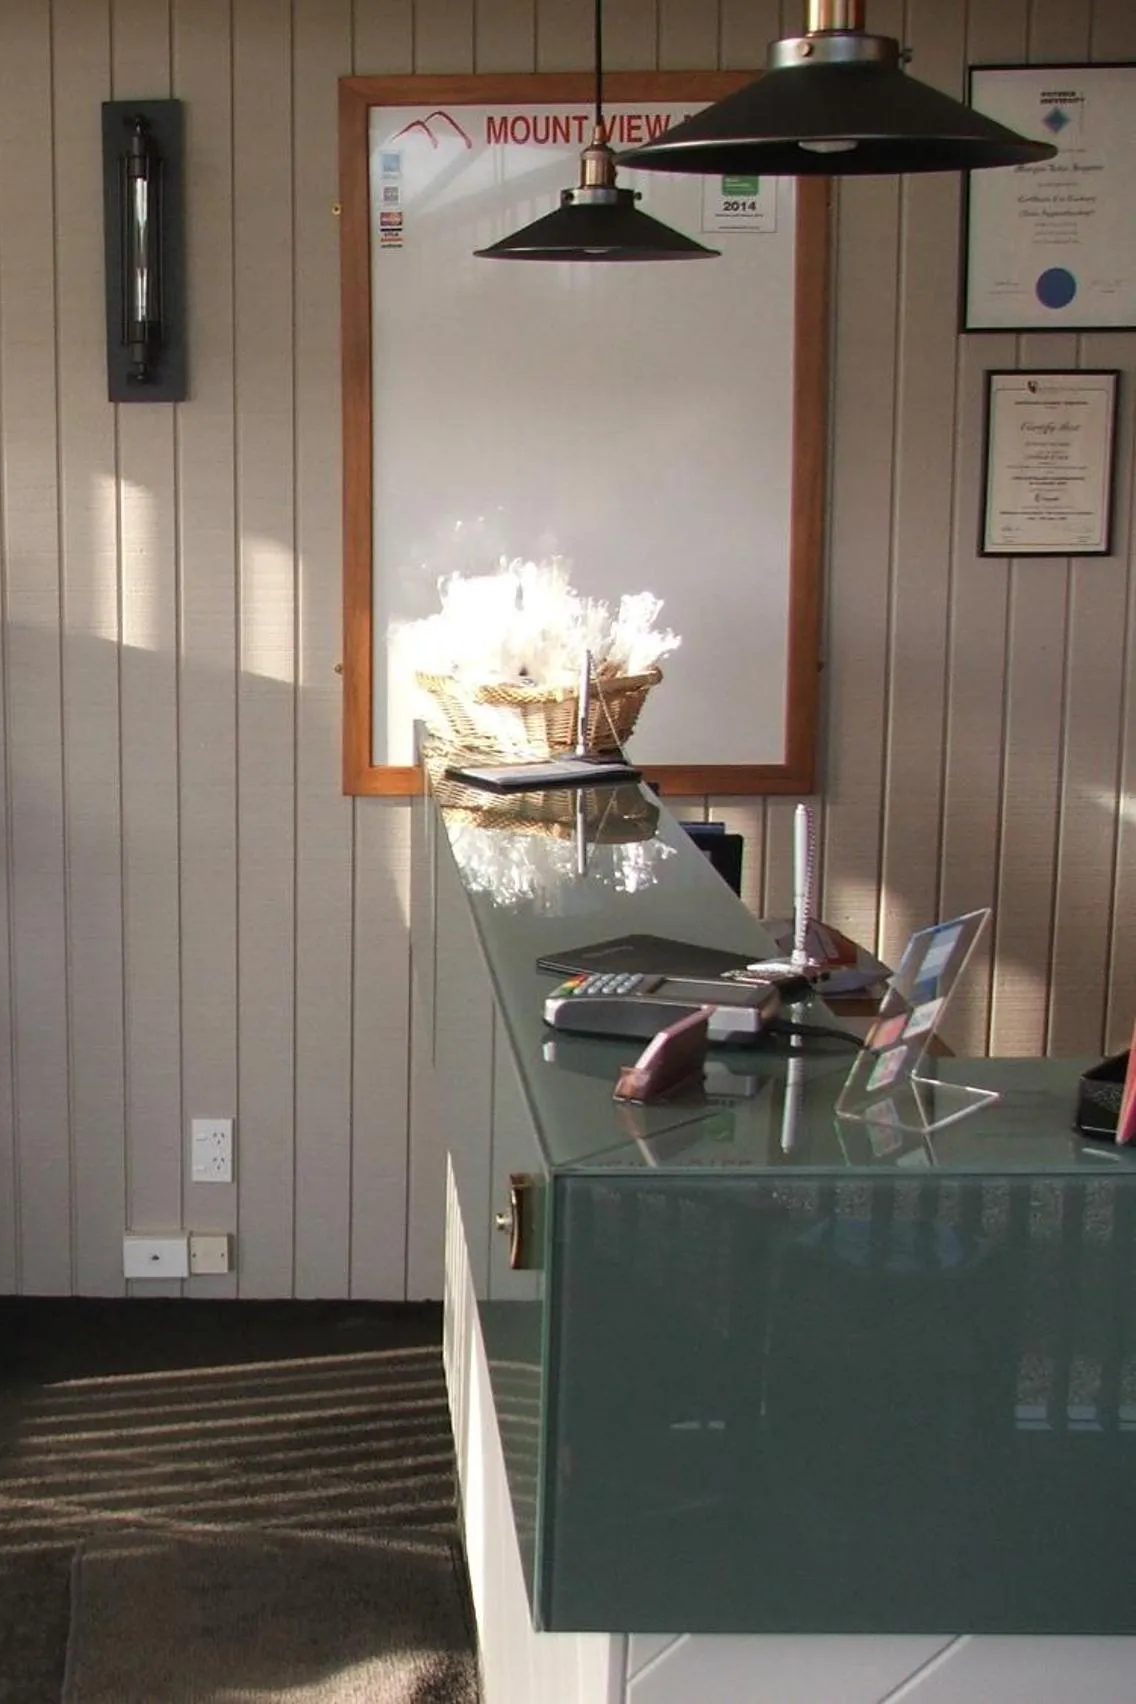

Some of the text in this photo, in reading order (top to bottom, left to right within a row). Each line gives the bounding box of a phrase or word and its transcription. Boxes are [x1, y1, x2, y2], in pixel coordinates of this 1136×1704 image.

[486, 114, 671, 144] MOUNT VIEW
[723, 201, 756, 212] 2014
